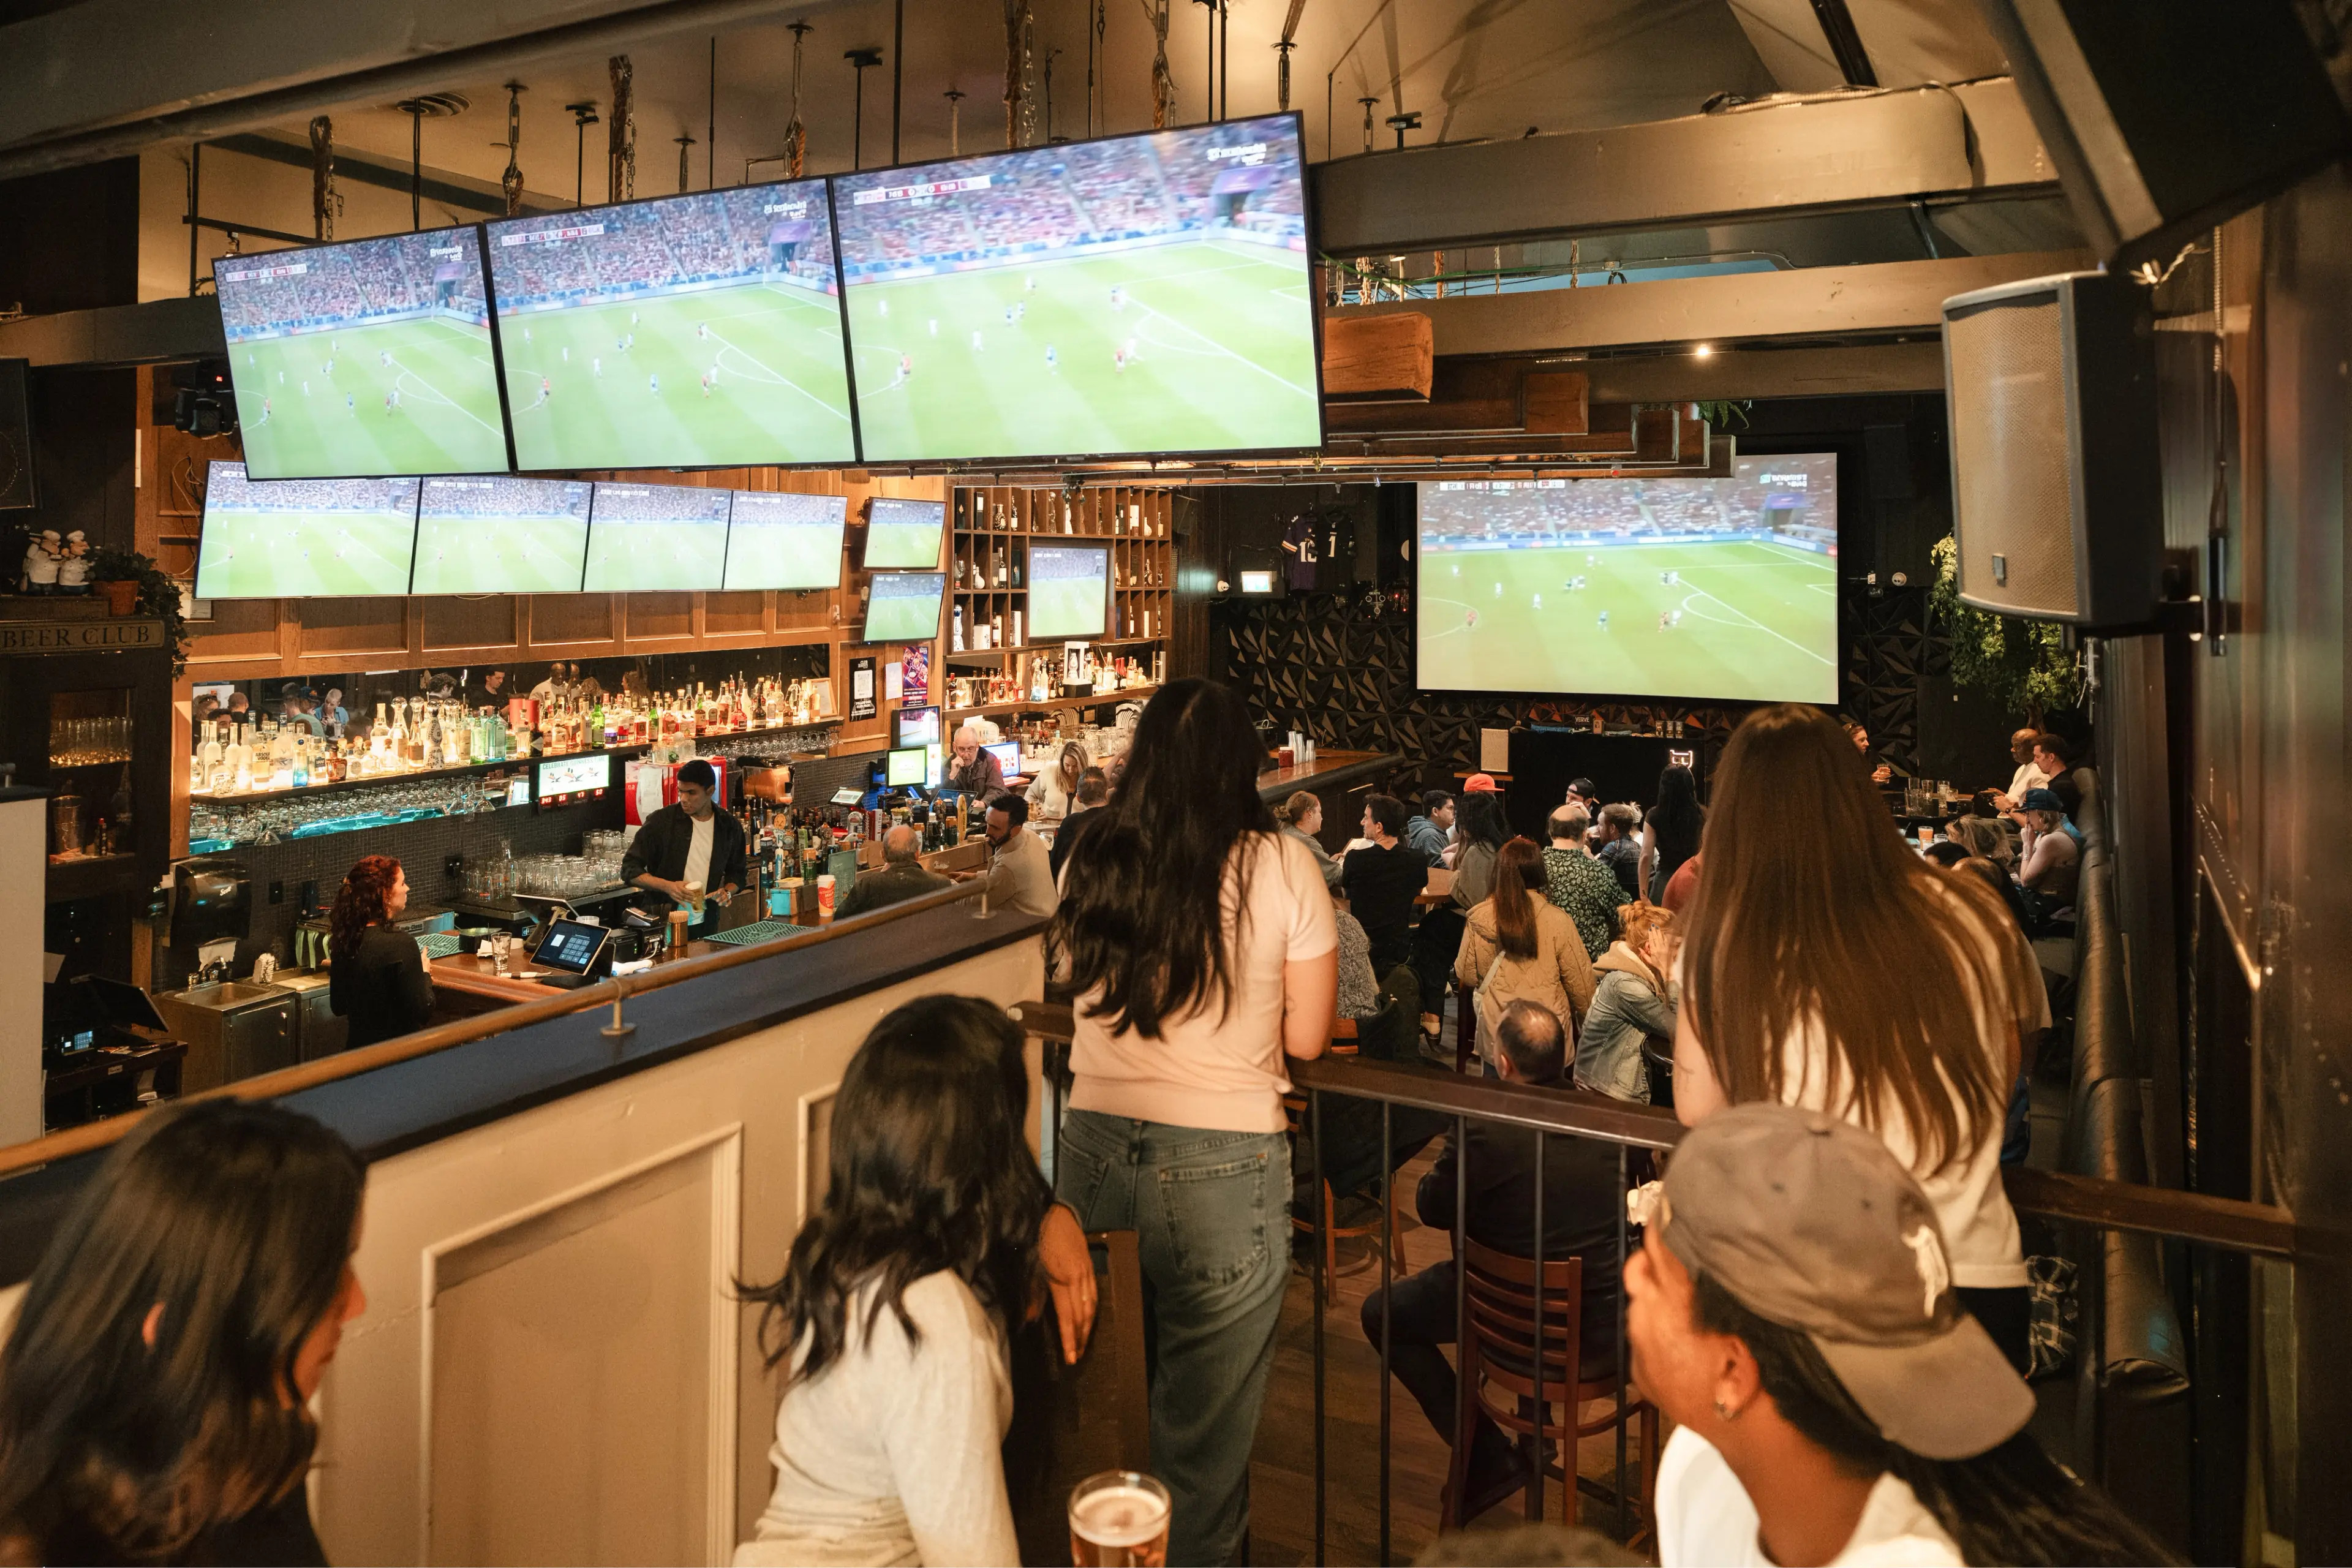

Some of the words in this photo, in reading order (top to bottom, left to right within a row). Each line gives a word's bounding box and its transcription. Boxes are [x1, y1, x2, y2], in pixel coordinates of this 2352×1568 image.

[1328, 535, 1336, 557] 1
[4, 628, 72, 648] BEER
[82, 625, 149, 644] CLUB
